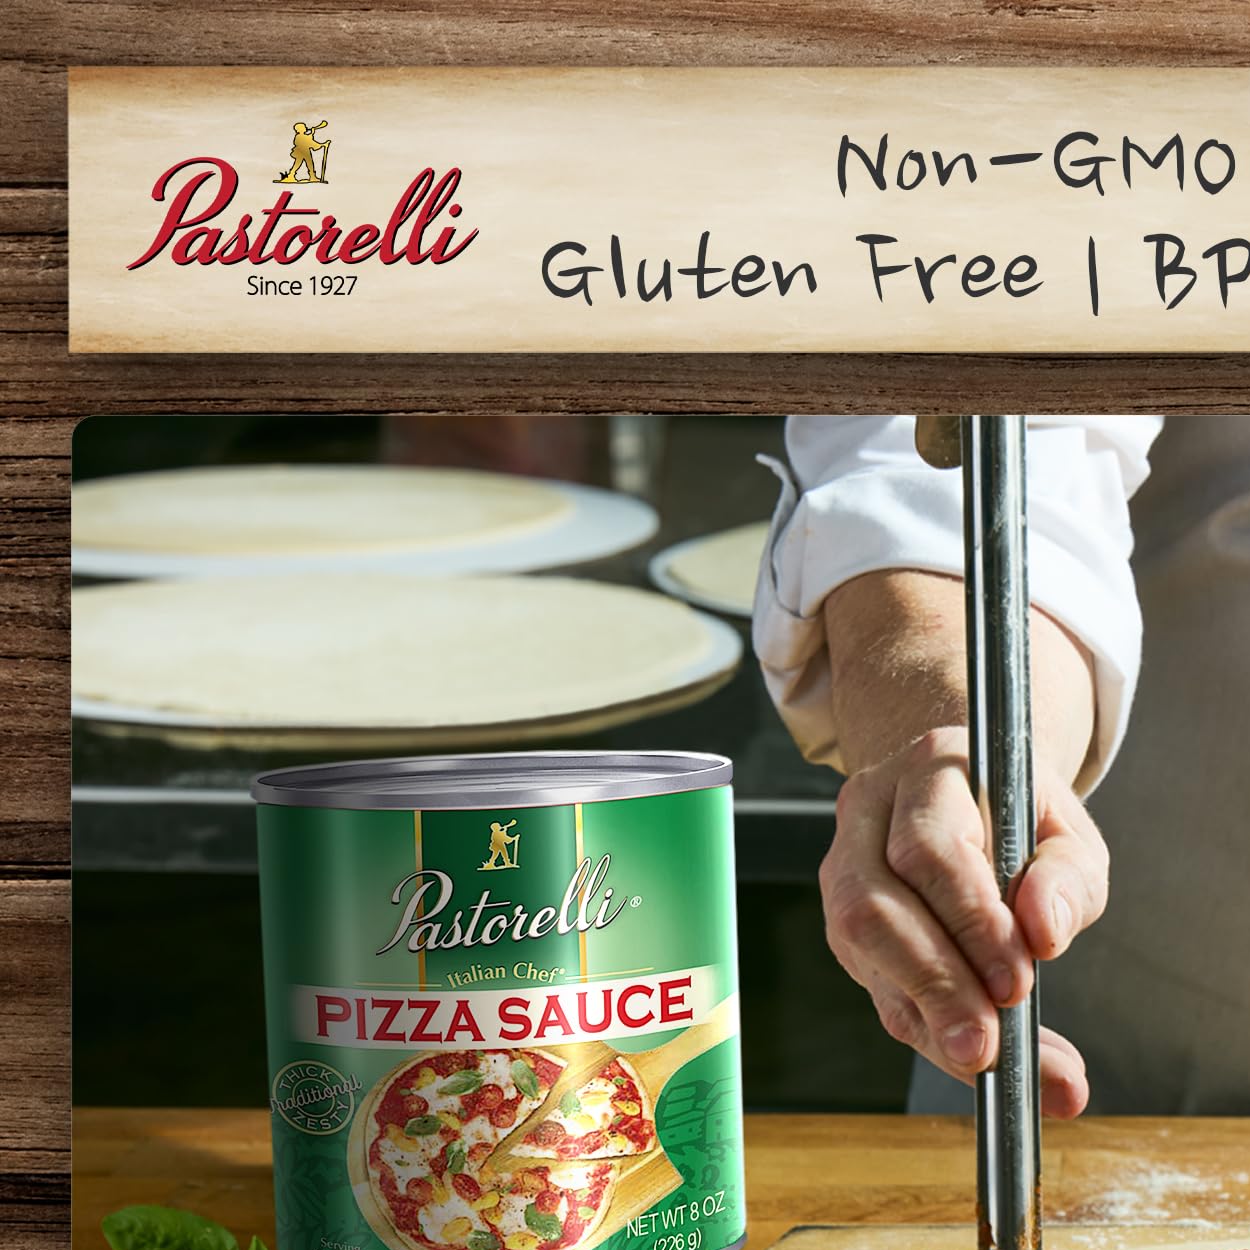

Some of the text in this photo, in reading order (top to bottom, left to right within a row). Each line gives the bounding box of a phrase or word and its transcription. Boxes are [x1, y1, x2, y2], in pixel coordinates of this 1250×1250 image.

[446, 964, 507, 988] Italian
[315, 976, 694, 1044] PIZZA SAUCE
[279, 1066, 332, 1090] THICK
[292, 1100, 349, 1130] ZESTY
[626, 1190, 726, 1239] NET WT 8 OZ
